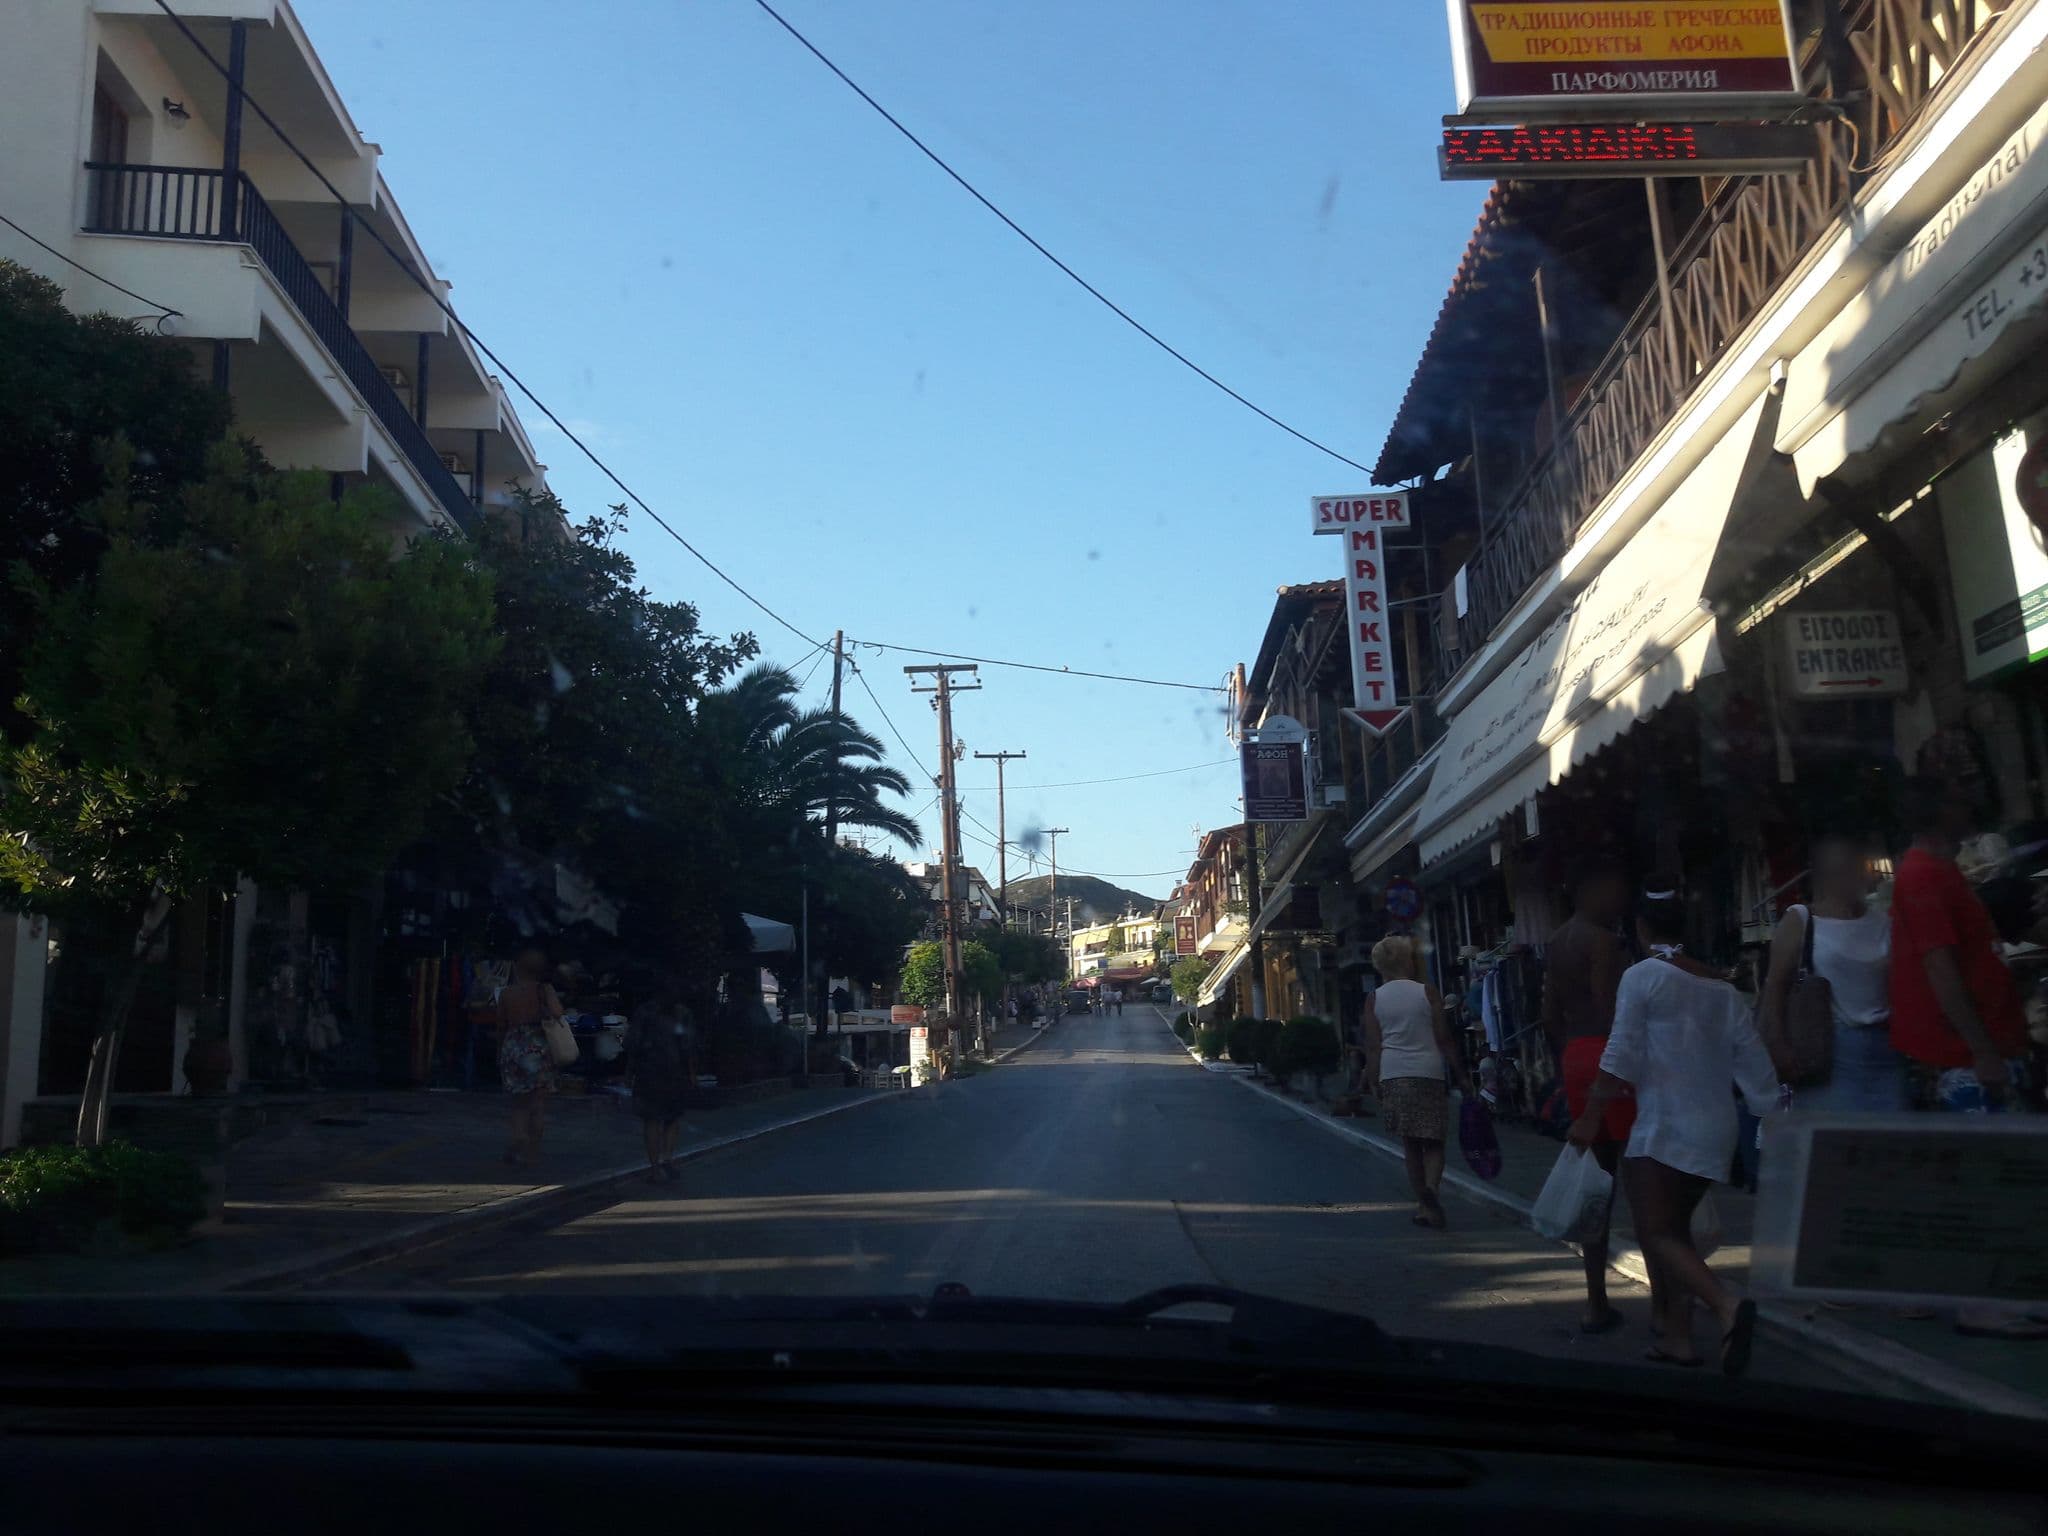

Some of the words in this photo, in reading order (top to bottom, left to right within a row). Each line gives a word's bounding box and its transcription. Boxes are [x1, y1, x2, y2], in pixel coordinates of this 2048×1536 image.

[1481, 11, 1655, 31] ТРАДИЦИОННЫЕ
[1663, 8, 1781, 28] ГРЕЧЕСКИЕ
[1525, 36, 1641, 55] ПРОДУКТЫ
[1669, 35, 1743, 52] АФОНА
[1552, 70, 1719, 91] ПАРФЮМЕРИЯ
[1962, 288, 2013, 340] TEL.
[1319, 499, 1403, 523] SUPER
[1352, 530, 1385, 701] MARKET
[1797, 646, 1901, 673] ENTRANCE
